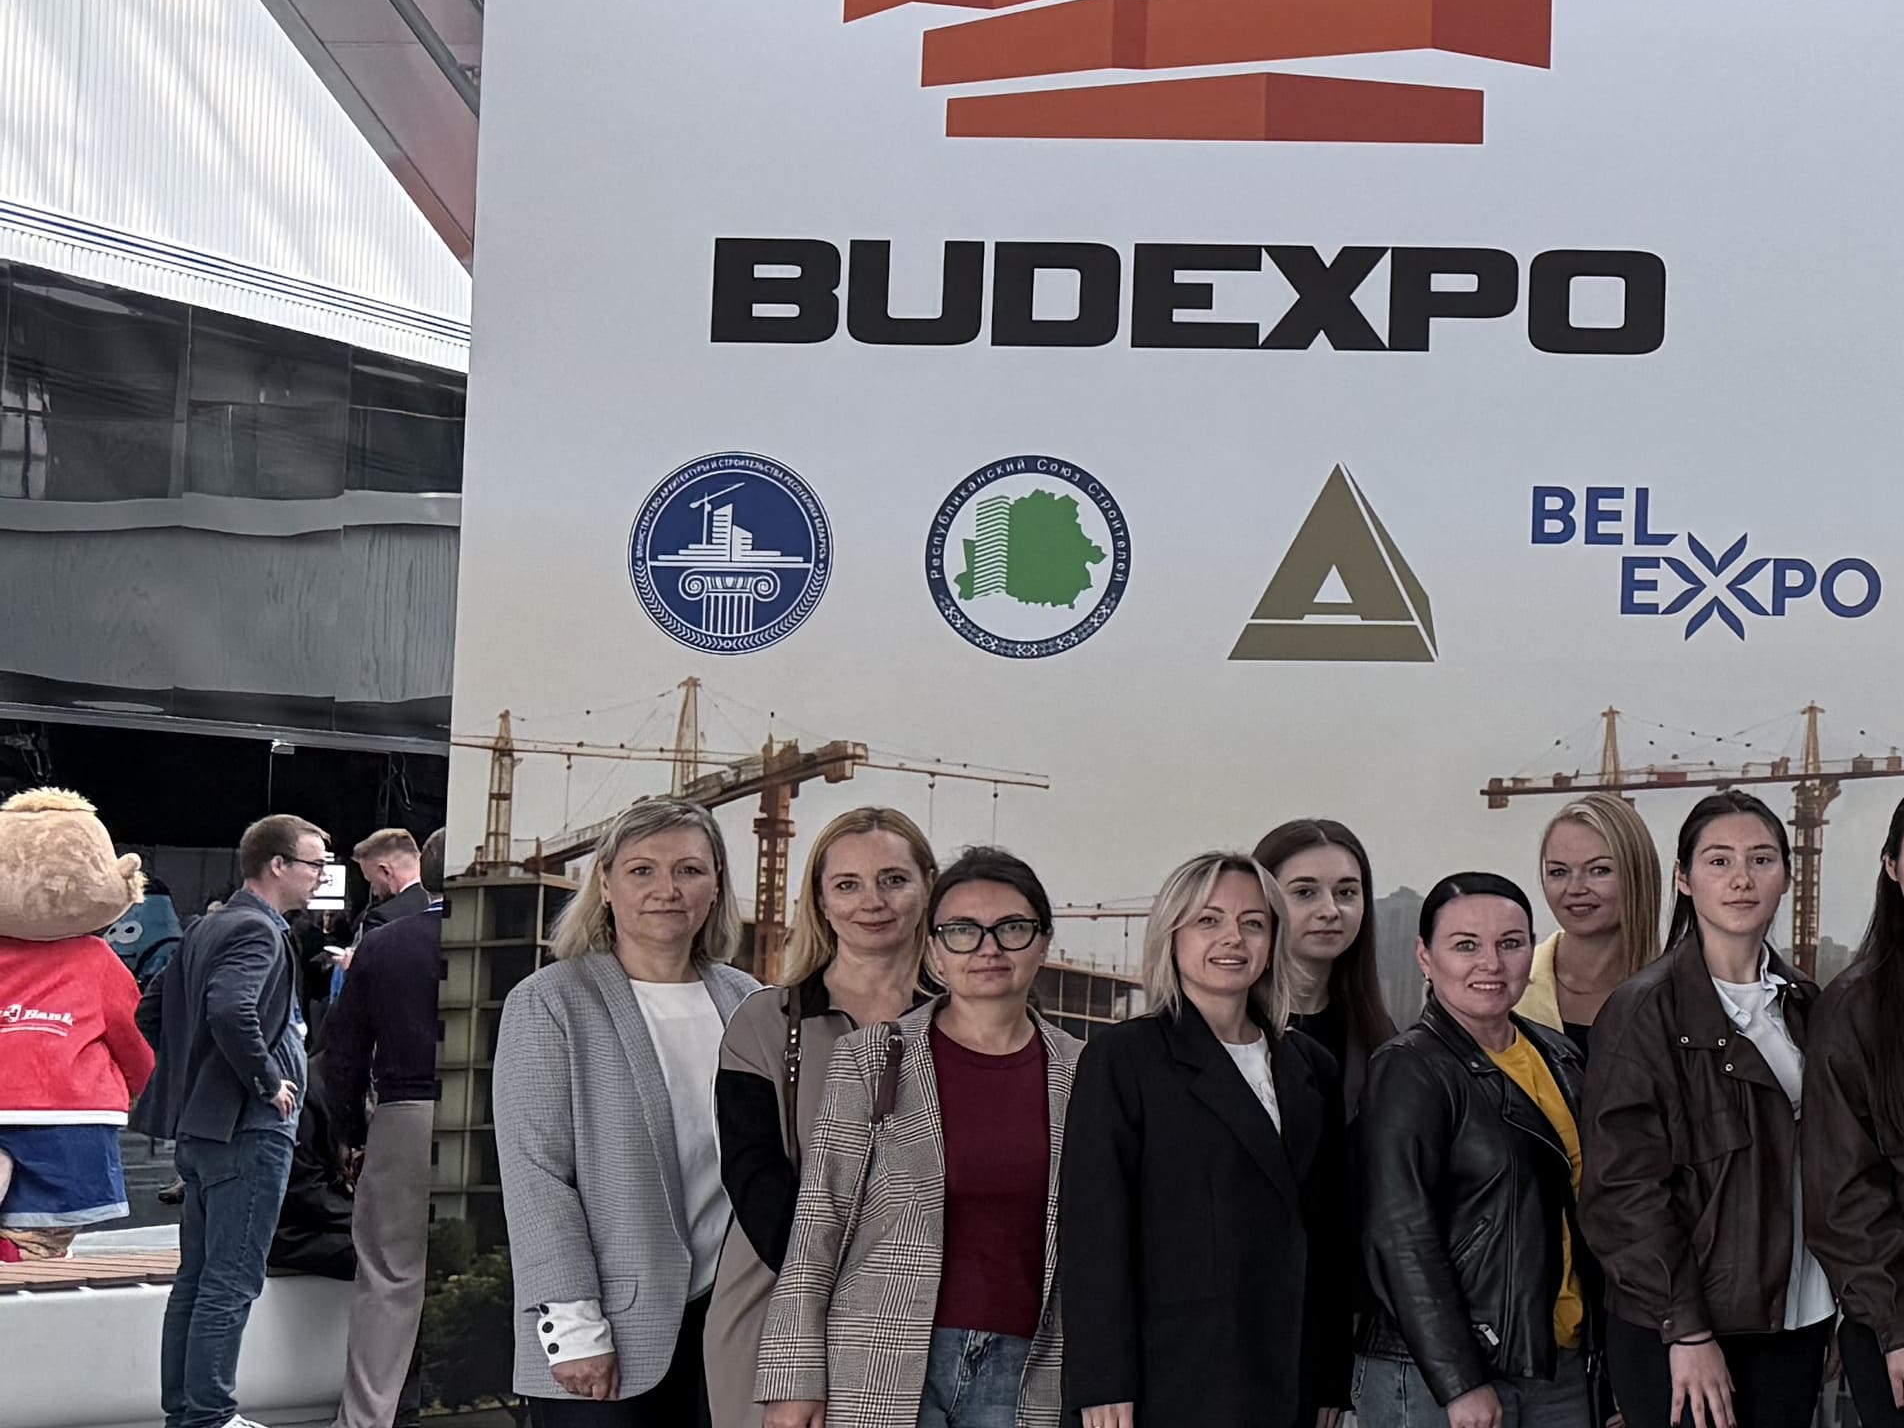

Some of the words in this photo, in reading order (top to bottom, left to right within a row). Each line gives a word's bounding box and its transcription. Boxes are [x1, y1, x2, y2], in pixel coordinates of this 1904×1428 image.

[711, 238, 1666, 355] BUDEXPO
[1037, 459, 1081, 482] Союз
[1532, 486, 1678, 546] BEL
[1621, 531, 1881, 641] EXPO
